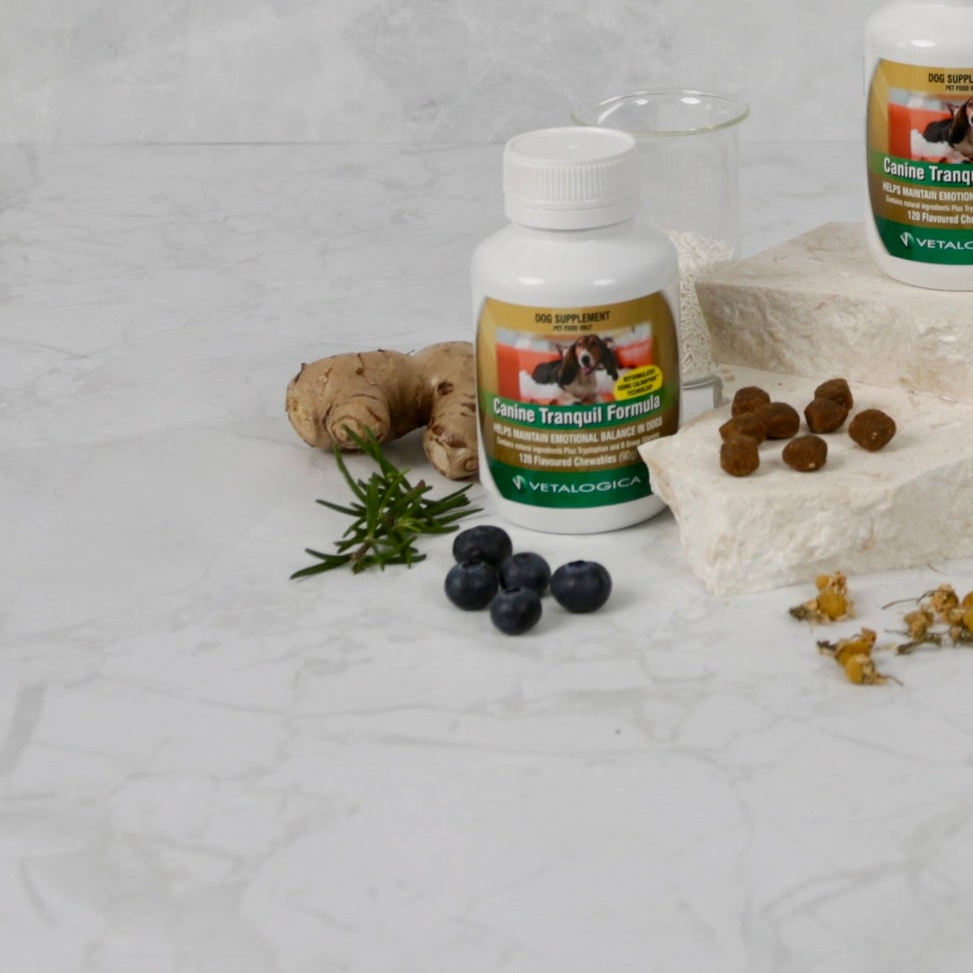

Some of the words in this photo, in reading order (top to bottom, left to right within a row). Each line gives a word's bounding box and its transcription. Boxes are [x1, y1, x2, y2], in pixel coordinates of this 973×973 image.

[928, 73, 944, 83] DOG
[883, 157, 925, 180] Canine
[882, 182, 900, 194] HELPS
[902, 187, 937, 200] MAINTAIN
[908, 210, 920, 220] 120
[922, 212, 958, 224] Flavoured
[535, 314, 552, 324] DOG
[555, 311, 611, 324] SUPPLEMENT
[493, 398, 535, 422] Canine
[538, 407, 602, 428] Tranquil
[607, 395, 660, 421] Formula
[513, 428, 549, 443] MAINTAIN
[550, 433, 599, 444] EMOTIONAL
[600, 426, 636, 441] BALANCE
[638, 424, 645, 434] IN
[520, 453, 532, 464] 120
[534, 456, 572, 467] Flavoured
[574, 456, 616, 467] Chewables
[529, 476, 641, 493] VETALOGICA
